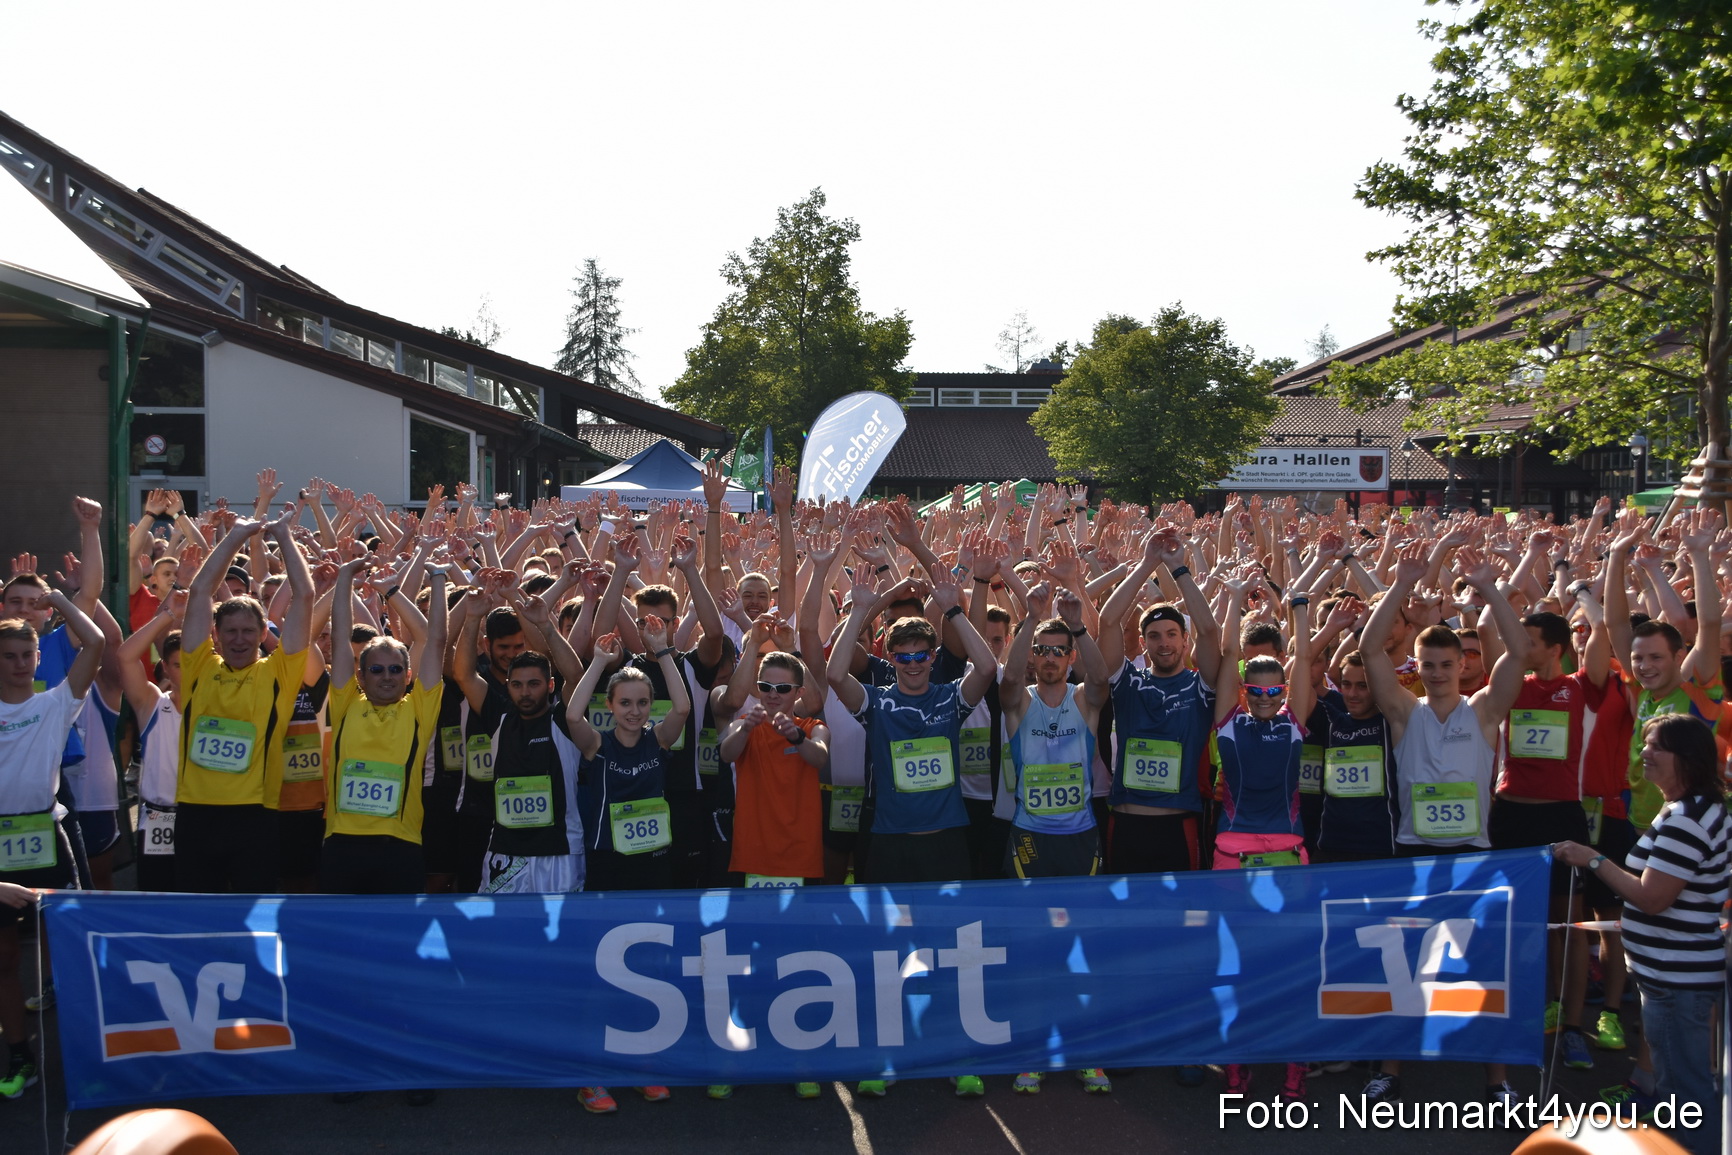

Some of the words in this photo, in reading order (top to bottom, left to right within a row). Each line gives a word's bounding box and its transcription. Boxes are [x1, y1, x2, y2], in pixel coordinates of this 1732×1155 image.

[823, 409, 884, 493] Fischer
[843, 424, 890, 492] AUTOMOBILE
[1293, 453, 1350, 466] Hallen
[1526, 729, 1550, 745] 27
[198, 737, 247, 760] 1359
[288, 752, 321, 769] 430
[905, 758, 942, 778] 956
[1135, 759, 1169, 778] 958
[1336, 765, 1369, 784] 381
[345, 780, 394, 802] 1361
[1028, 786, 1081, 808] 5193
[502, 796, 547, 815] 1089
[1426, 804, 1466, 823] 353
[623, 818, 659, 840] 368
[3, 836, 43, 857] 113
[595, 920, 1012, 1055] Start
